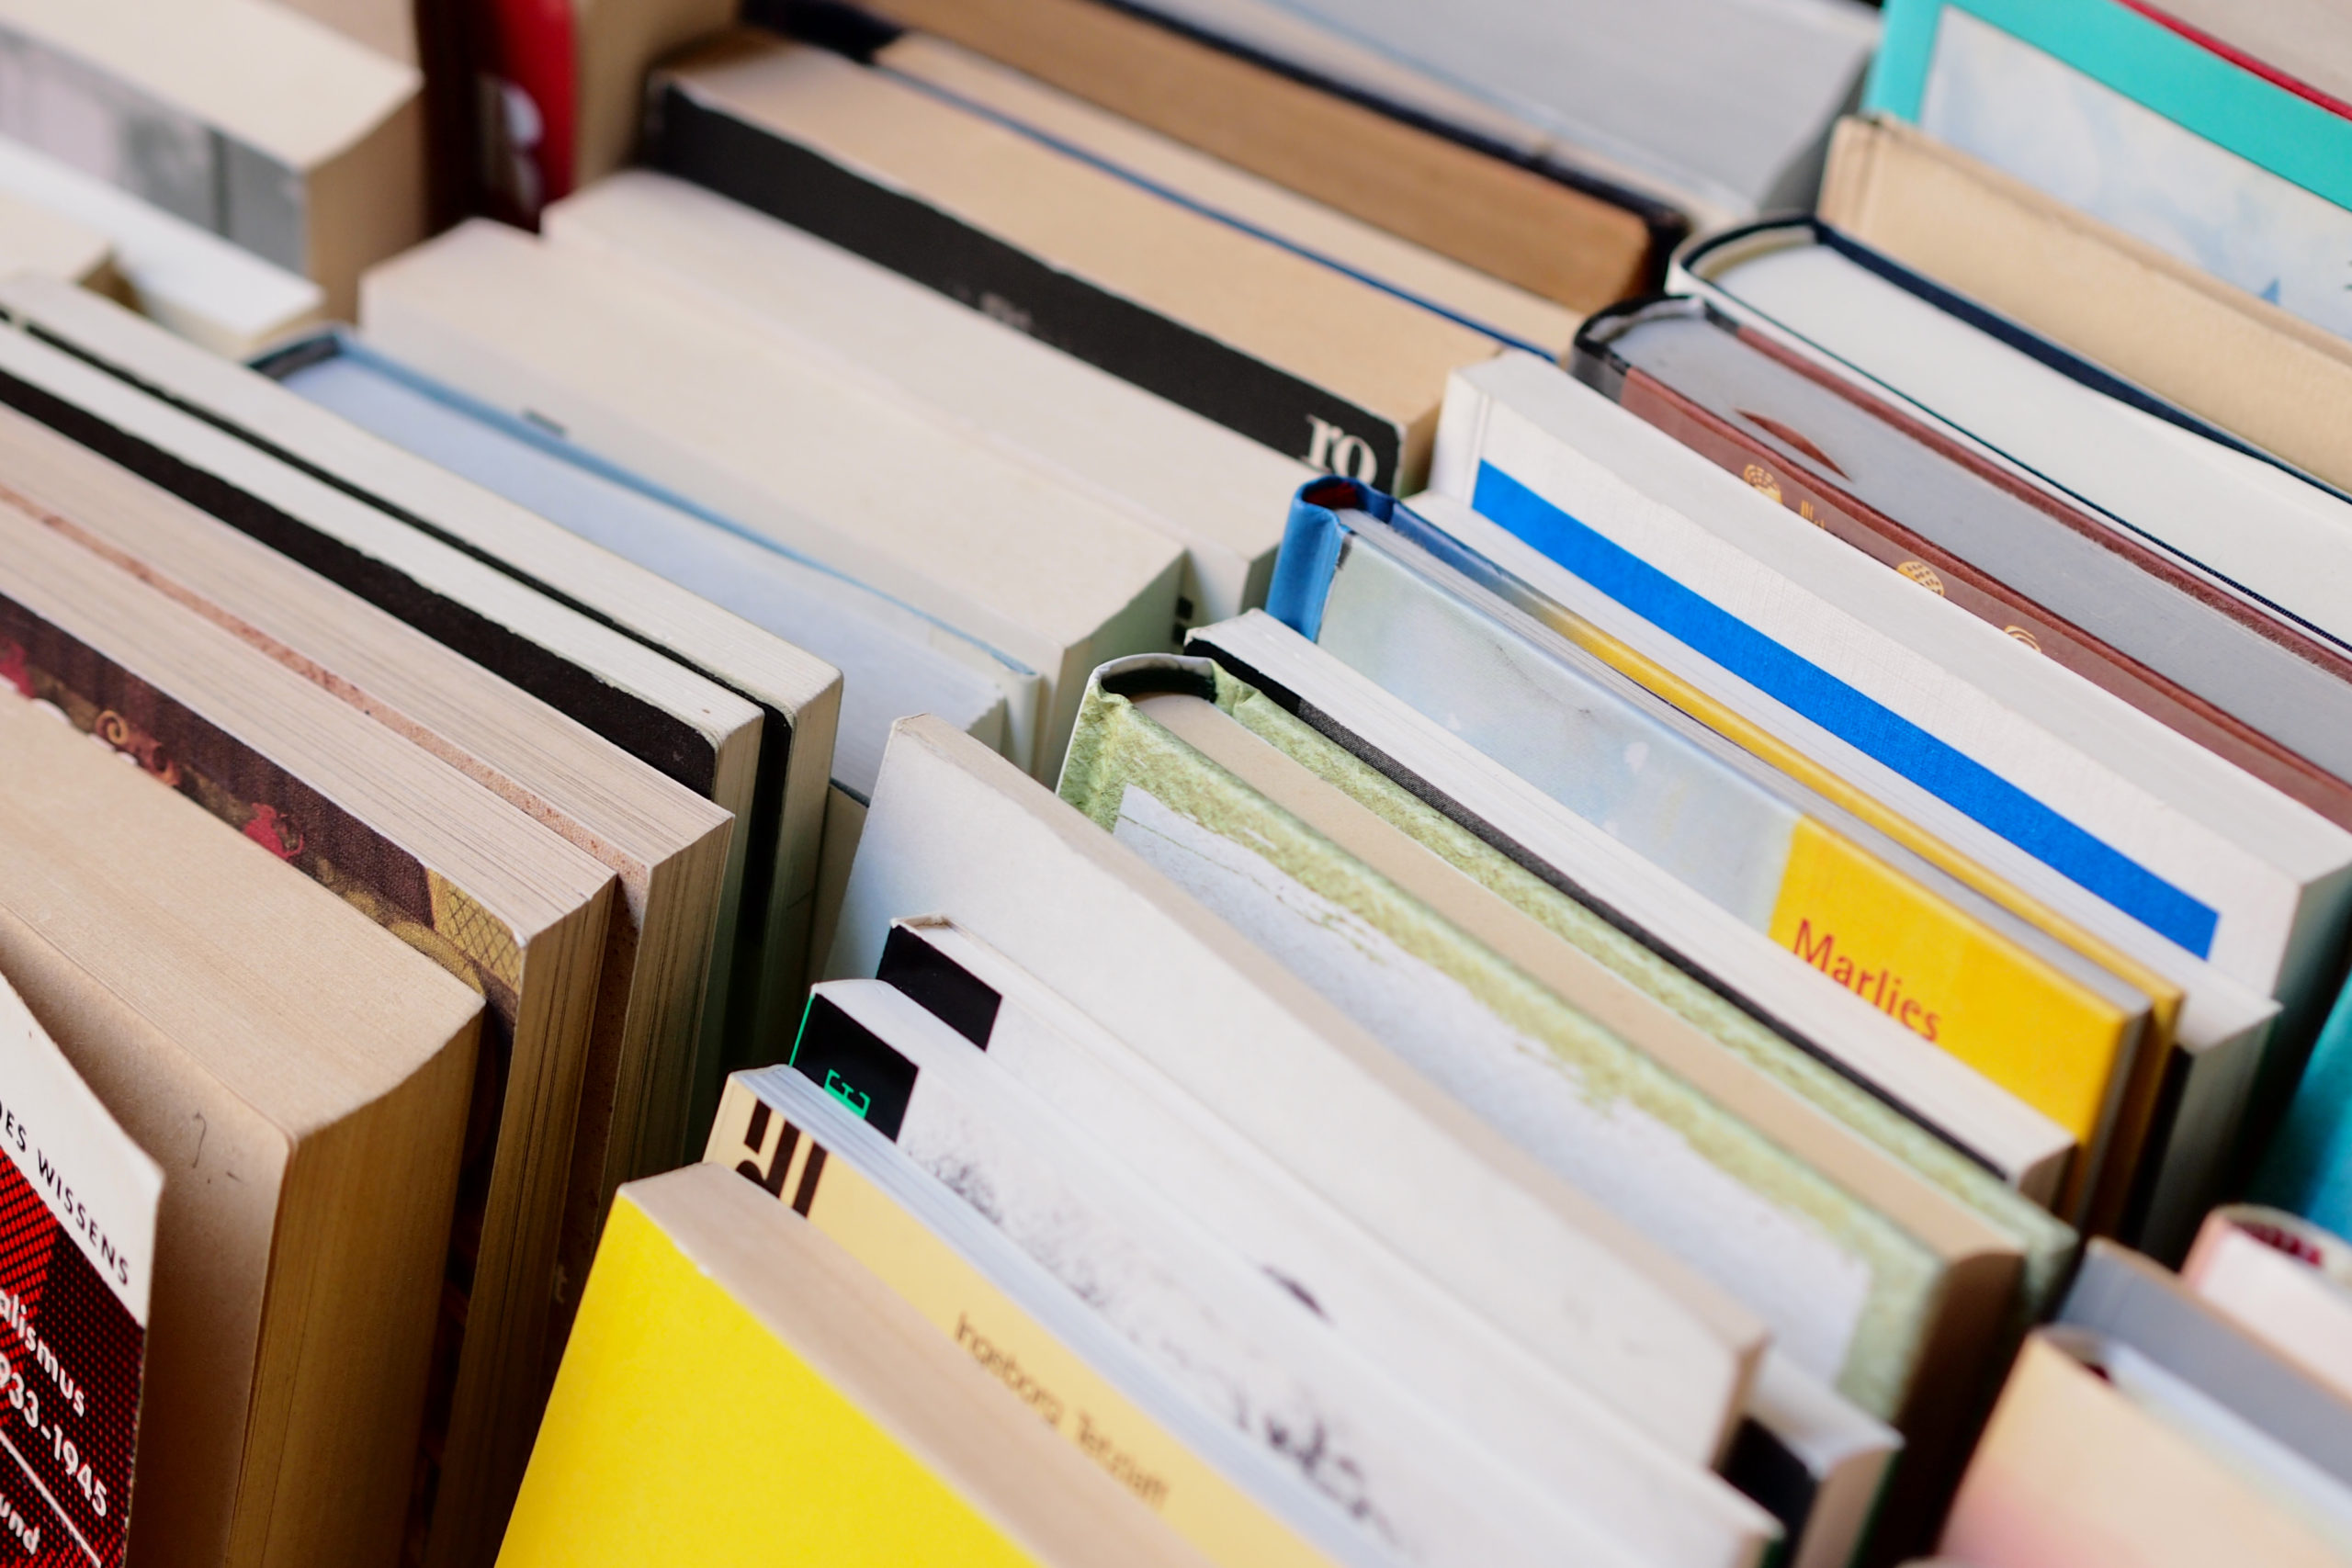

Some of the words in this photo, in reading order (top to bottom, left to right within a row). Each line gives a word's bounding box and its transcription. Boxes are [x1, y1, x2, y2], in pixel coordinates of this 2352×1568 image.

[1299, 413, 1377, 488] ro
[1793, 917, 1941, 1043] Marlies
[0, 1100, 27, 1153] ES
[37, 1147, 129, 1286] WISSENS
